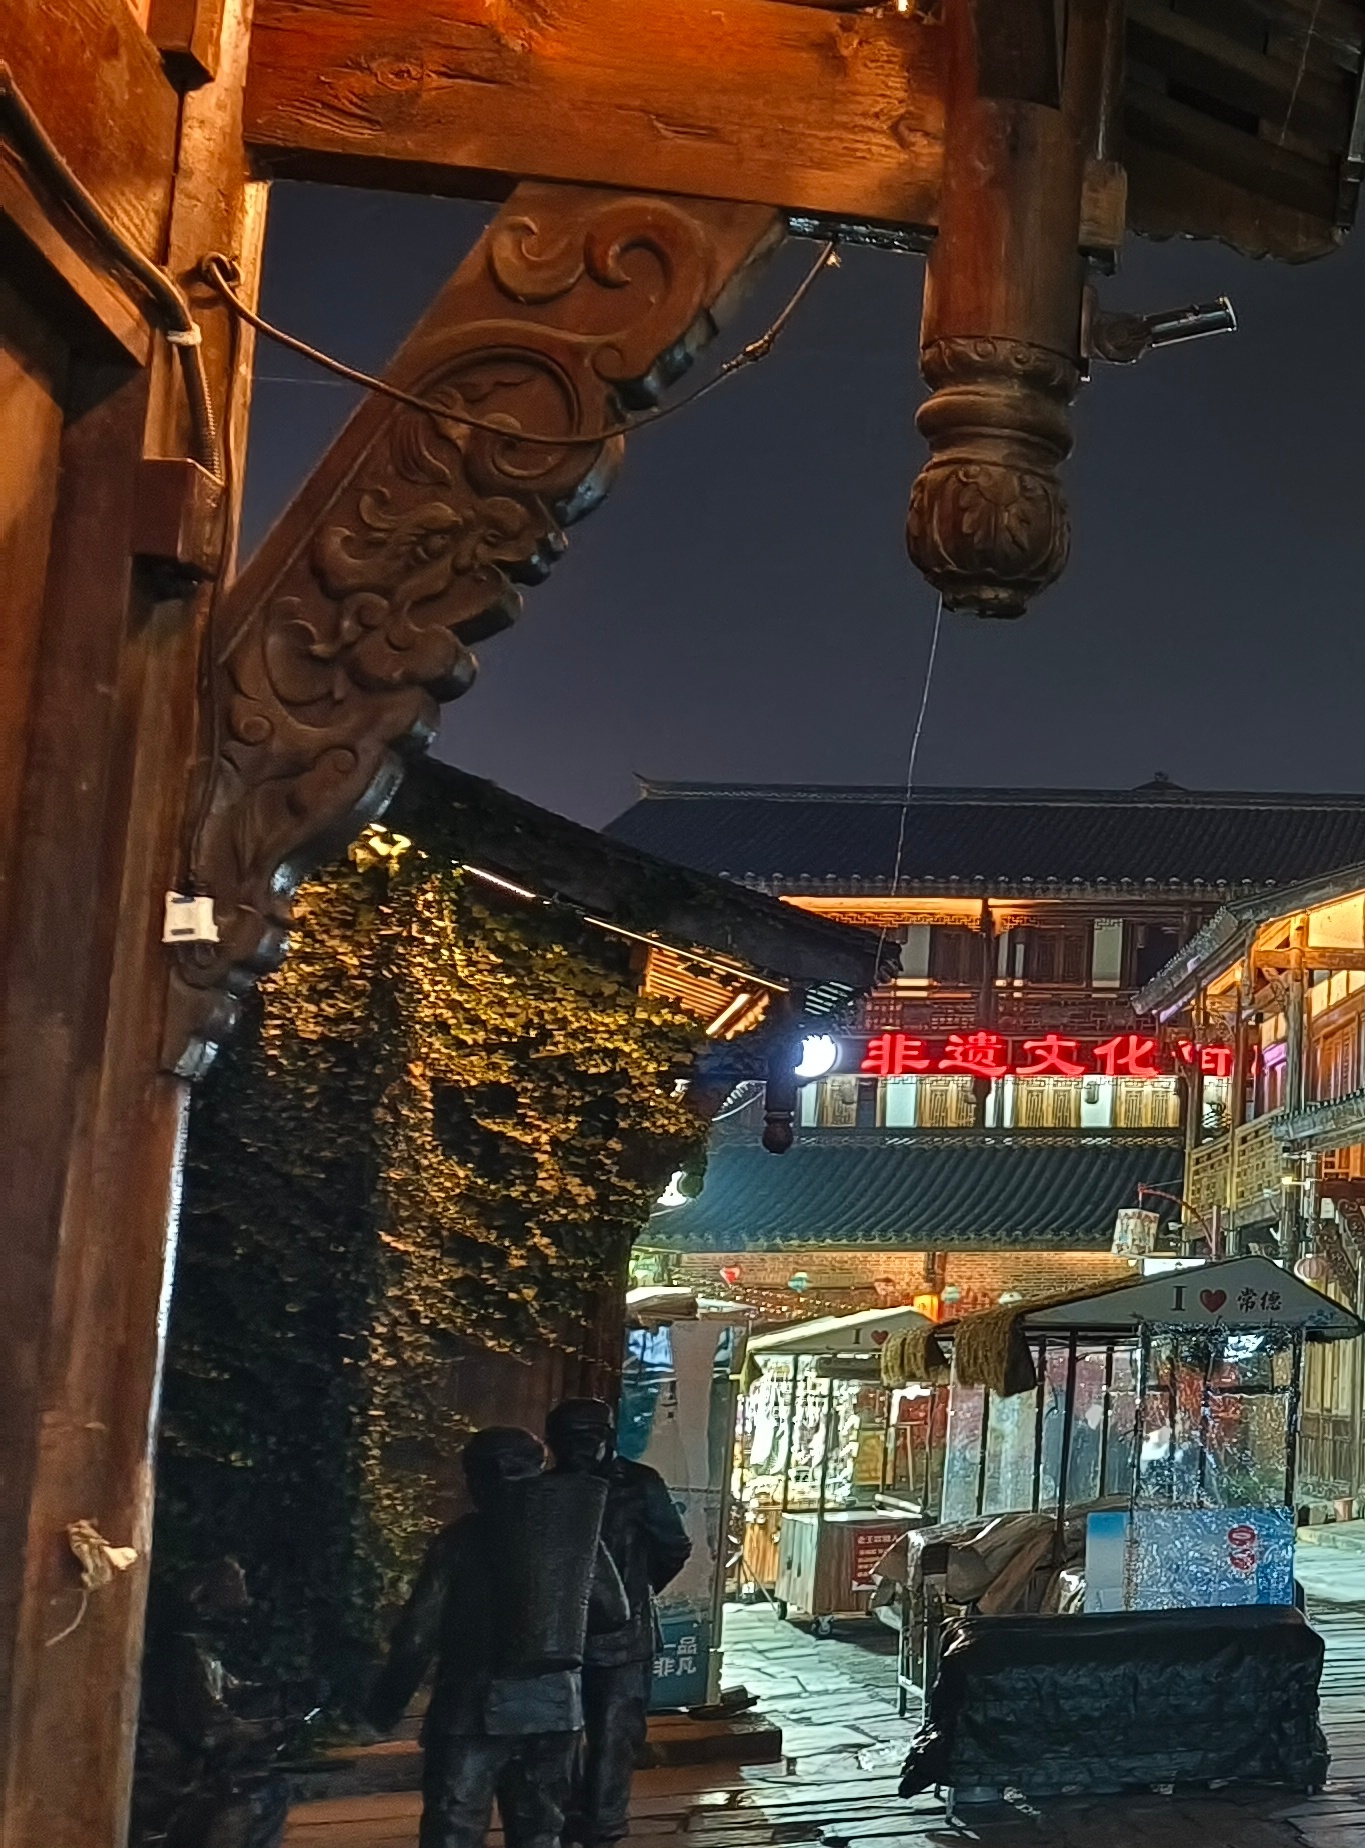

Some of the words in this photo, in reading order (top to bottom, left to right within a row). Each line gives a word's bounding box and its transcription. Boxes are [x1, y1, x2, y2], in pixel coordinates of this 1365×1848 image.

[1170, 1285, 1187, 1312] I
[1237, 1287, 1283, 1313] 常德
[663, 1636, 698, 1655] 一品
